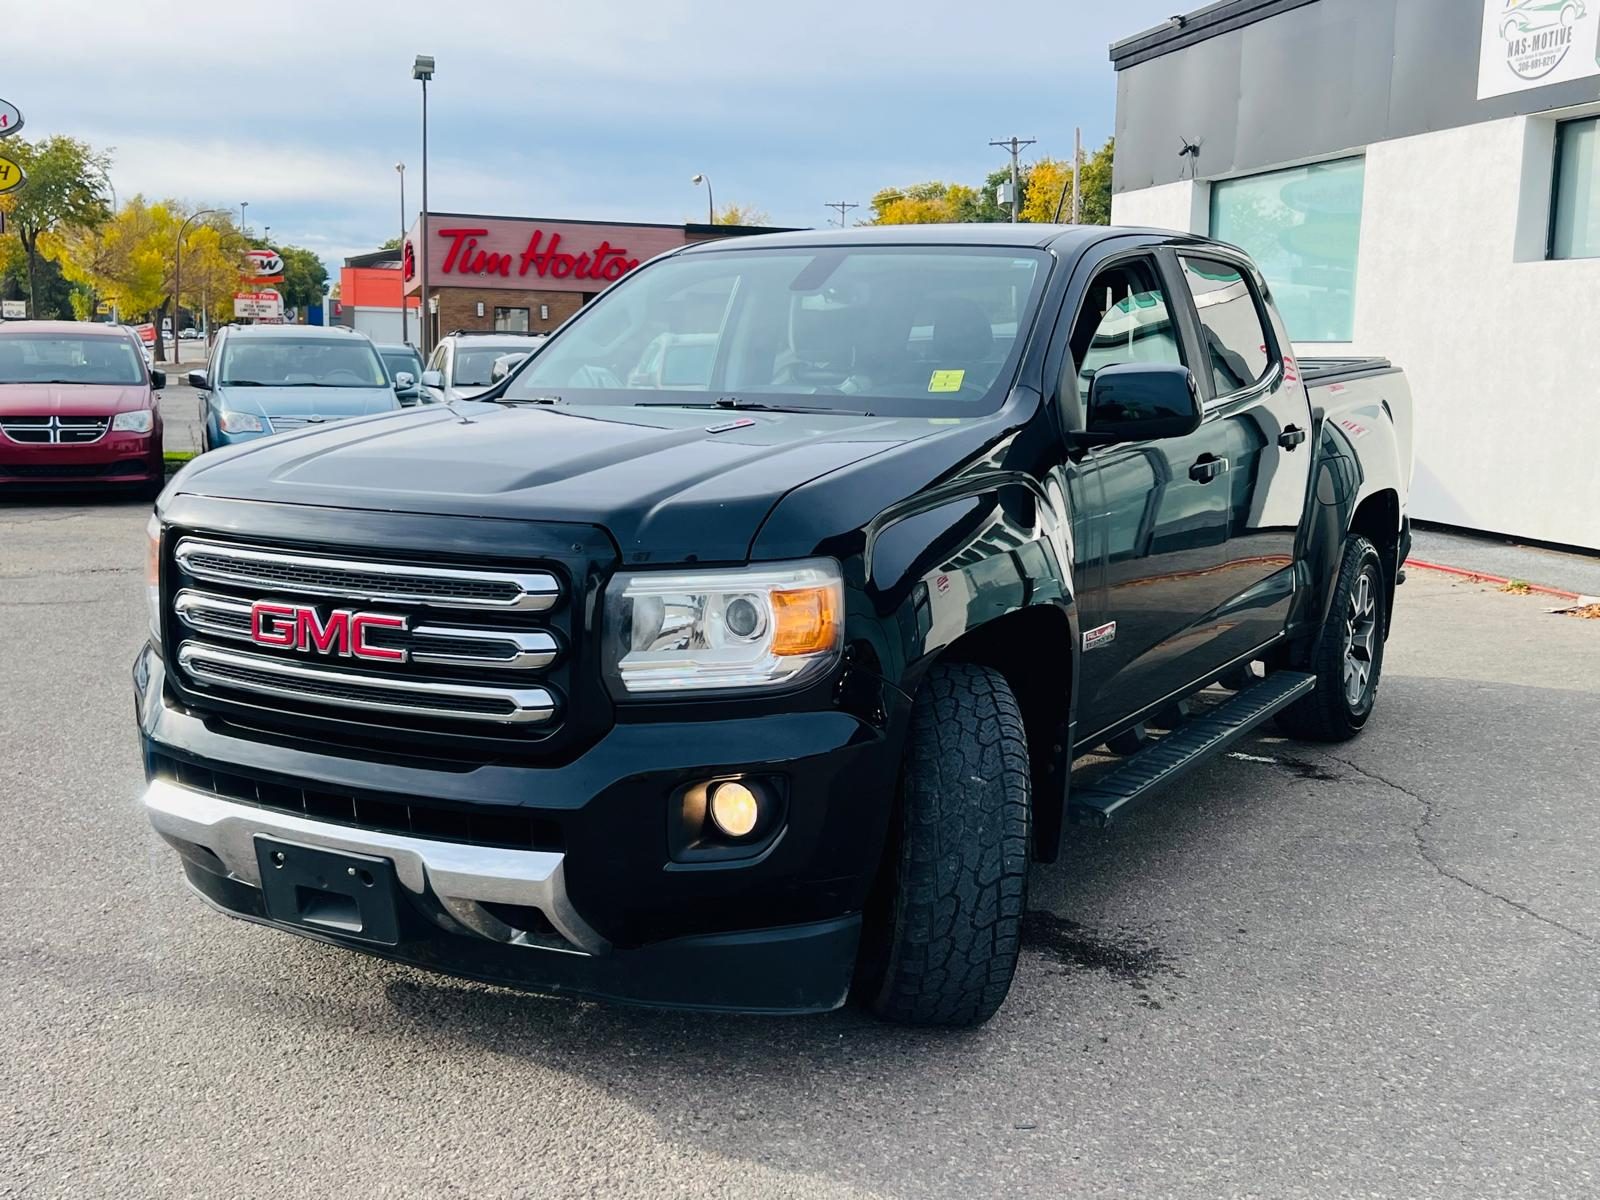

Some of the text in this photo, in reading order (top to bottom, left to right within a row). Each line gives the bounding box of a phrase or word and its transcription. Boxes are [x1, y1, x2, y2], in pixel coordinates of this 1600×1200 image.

[1507, 26, 1572, 58] NAS-MOTIVE
[438, 228, 512, 277] Tim
[252, 601, 408, 663] GMC
